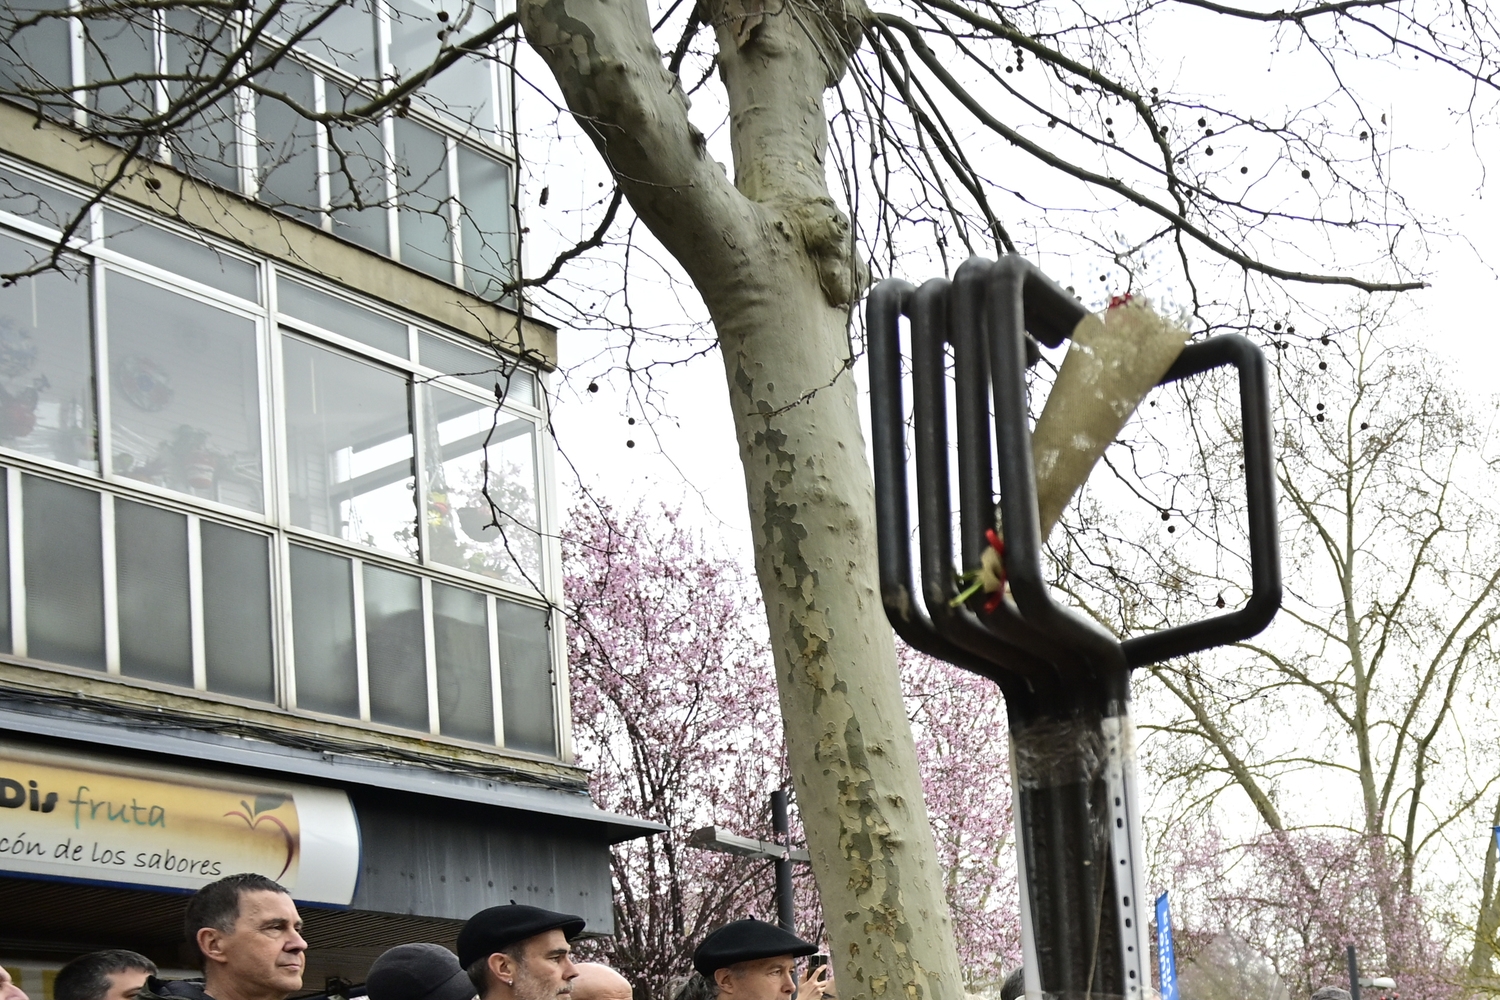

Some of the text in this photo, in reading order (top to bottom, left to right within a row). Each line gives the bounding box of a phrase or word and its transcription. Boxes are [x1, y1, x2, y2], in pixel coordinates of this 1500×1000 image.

[0, 777, 166, 830] Dis fruta
[54, 838, 83, 861] de
[92, 842, 126, 866] los
[134, 849, 222, 876] sabores
